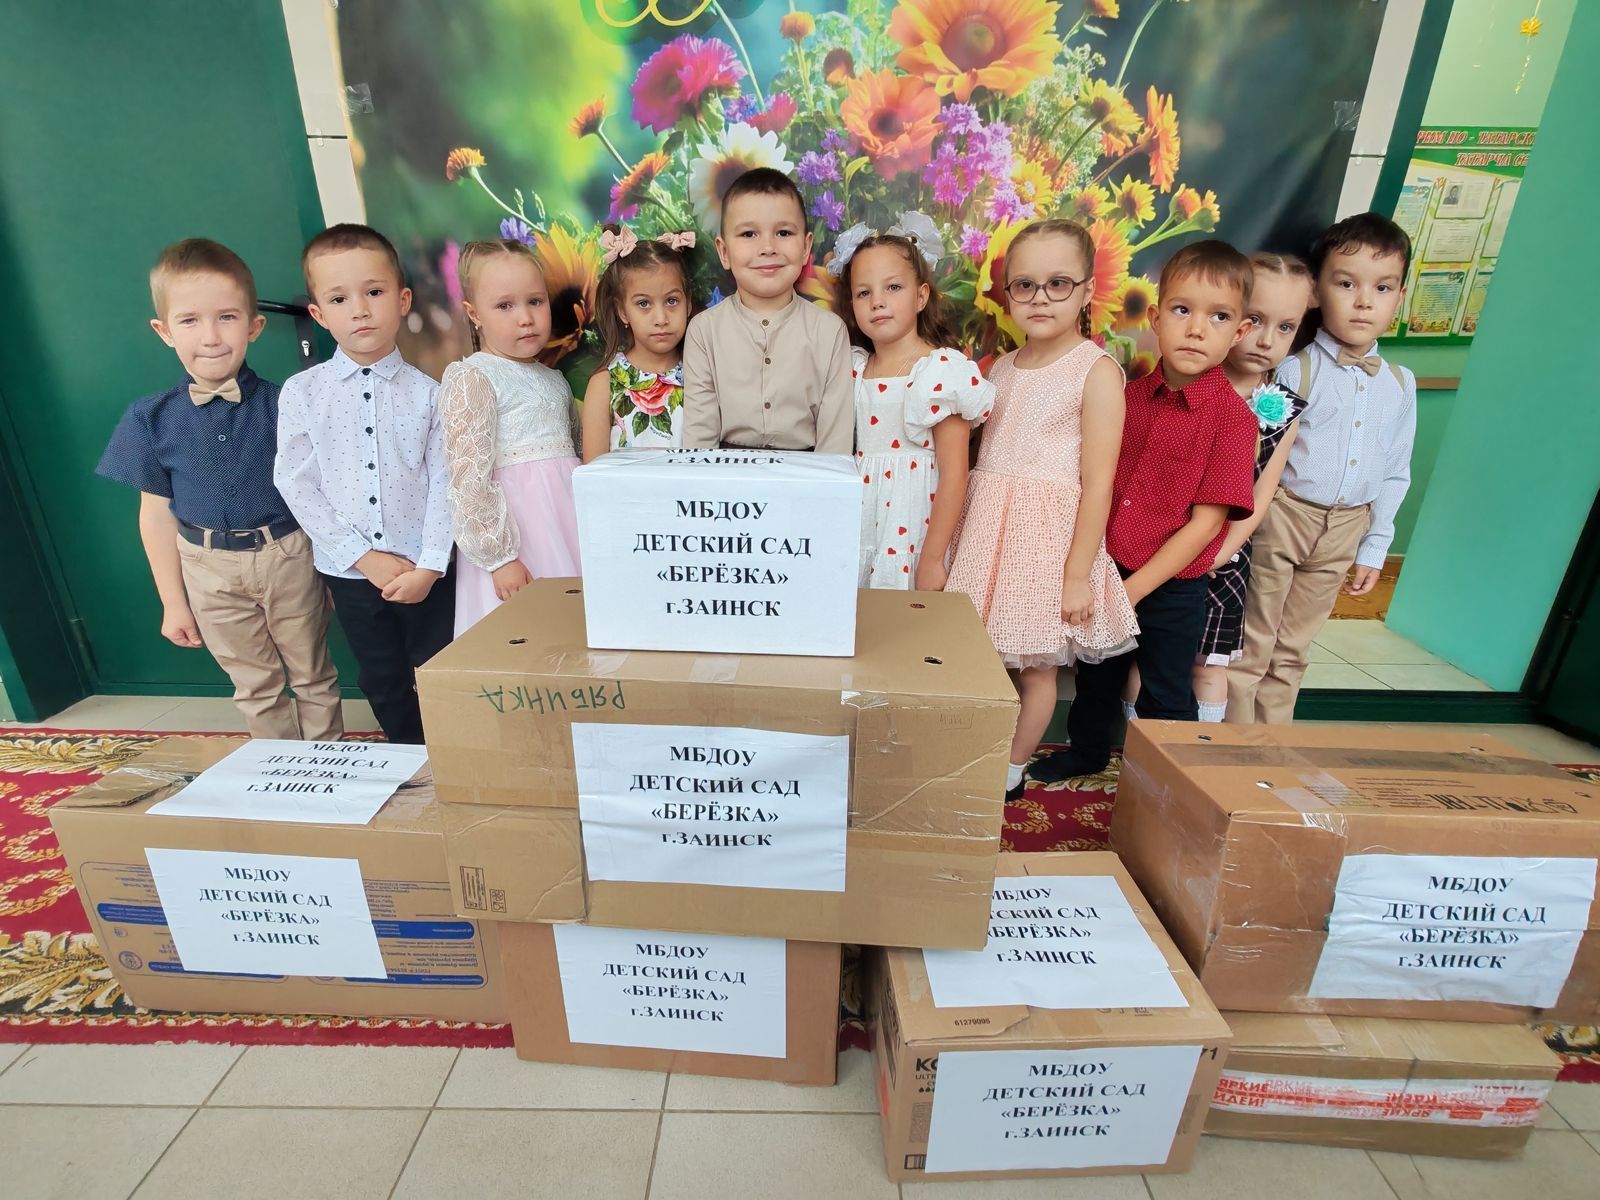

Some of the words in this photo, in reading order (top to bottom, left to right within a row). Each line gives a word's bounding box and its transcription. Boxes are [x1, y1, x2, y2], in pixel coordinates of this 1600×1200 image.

[676, 500, 768, 522] МБДОУ
[633, 533, 753, 554] ДЕТСКИЙ
[760, 537, 811, 558] САД
[656, 563, 789, 585] «БЕРЁЗКА»
[666, 598, 781, 617] г.ЗАИНСК
[476, 680, 626, 714] РЯБИНКА
[308, 743, 375, 753] МБДОУ
[669, 745, 757, 768] МБДОУ
[258, 755, 349, 766] ДЕТСКИЙ
[351, 758, 389, 769] САД
[260, 768, 358, 780] «БЕРЁЗКА»
[246, 782, 340, 794] г.ЗАИНСК
[629, 774, 745, 794] ДЕТСКИЙ
[751, 779, 801, 797] САД
[650, 800, 780, 823] «БЕРЁЗКА»
[661, 832, 773, 848] г.ЗАИНСК
[224, 867, 292, 884] МБДОУ
[1428, 875, 1514, 894] МБДОУ
[199, 887, 288, 904] ДЕТСКИЙ
[293, 894, 332, 908] САД
[221, 908, 320, 926] «БЕРЁЗКА»
[1057, 907, 1102, 920] САД
[1382, 903, 1496, 921] ДЕТСКИЙ
[1502, 907, 1547, 924] САД
[233, 930, 321, 946] г.ЗАИНСК
[1399, 927, 1520, 945] «БЕРЁЗКА»
[635, 943, 709, 959] МБДОУ
[997, 949, 1097, 965] г.ЗАИНСК
[1398, 954, 1506, 970] г.ЗАИНСК
[602, 963, 699, 981] ДЕТСКИЙ
[704, 969, 747, 985] САД
[622, 984, 729, 1002] «БЕРЁЗКА»
[631, 1006, 724, 1022] г.ЗАИНСК
[1028, 1062, 1113, 1077] МБДОУ
[983, 1084, 1095, 1101] ДЕТСКИЙ
[1100, 1084, 1146, 1097] САД
[1218, 1078, 1268, 1093] ЯРКИЕ
[1001, 1102, 1121, 1119] «БЕРЁЗКА»
[1004, 1124, 1111, 1139] г.ЗАИНСК
